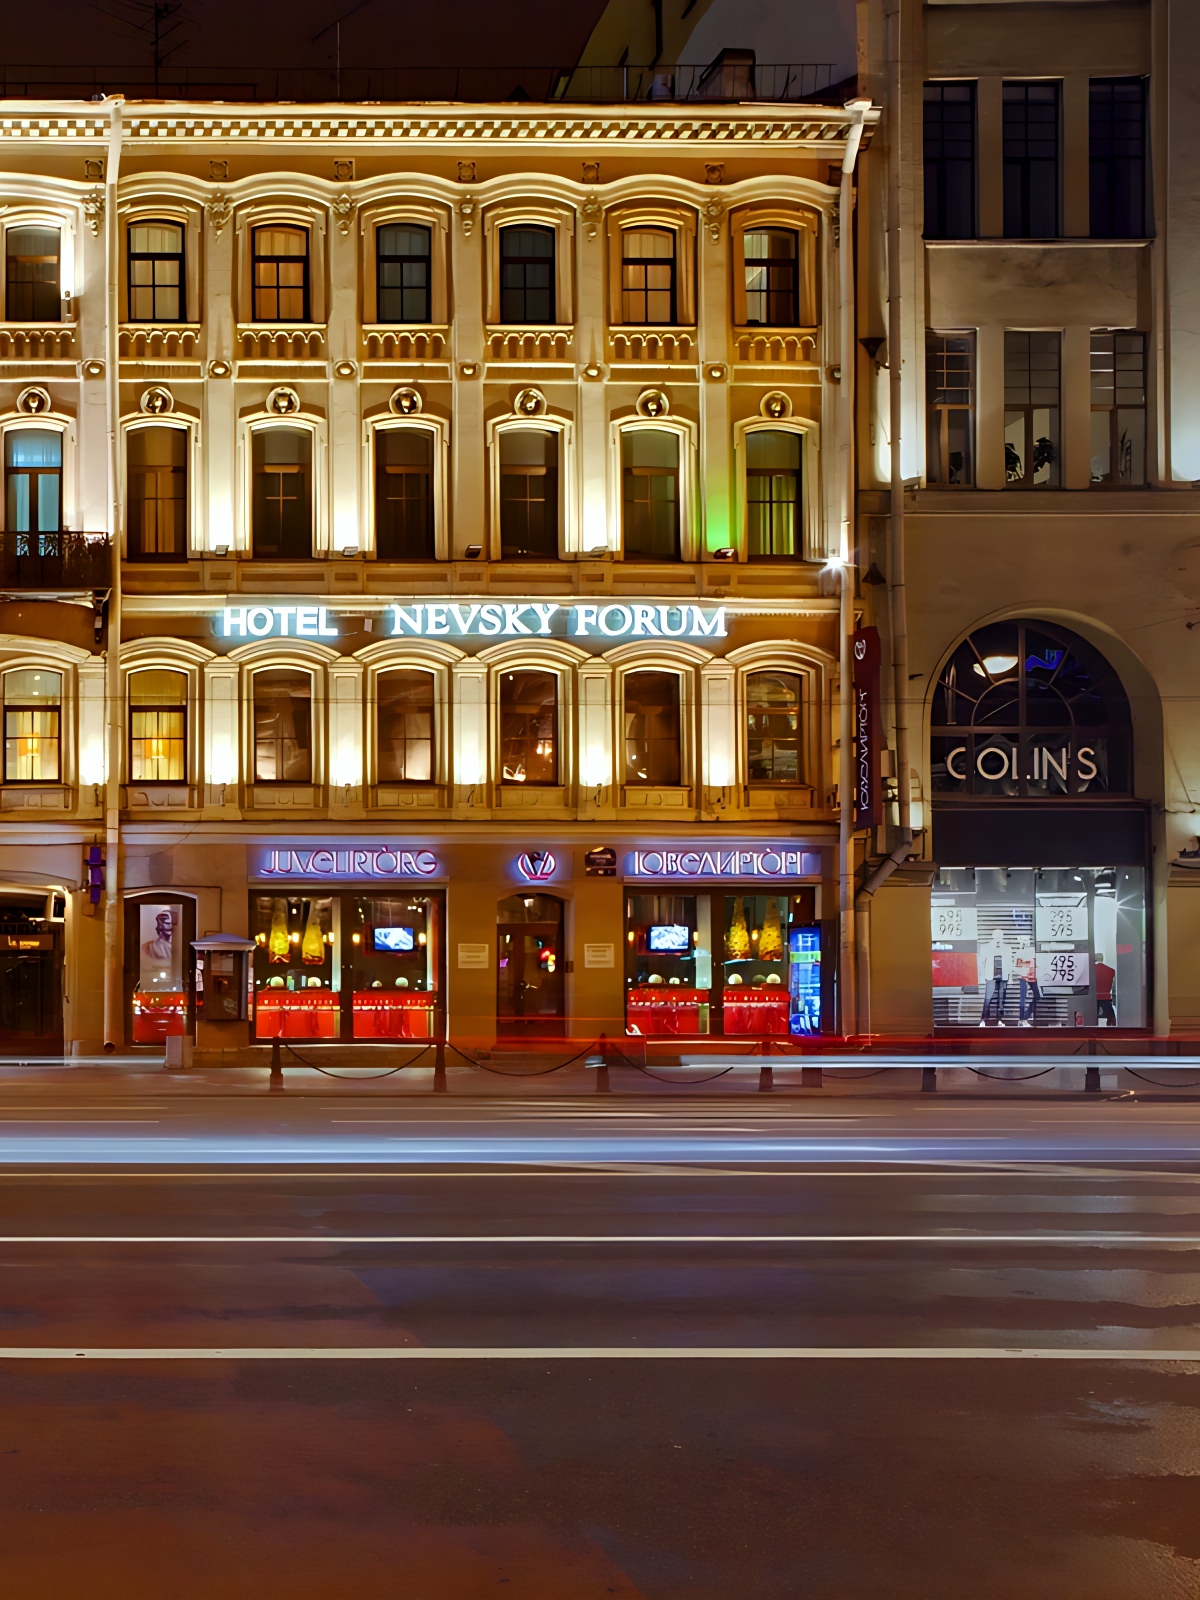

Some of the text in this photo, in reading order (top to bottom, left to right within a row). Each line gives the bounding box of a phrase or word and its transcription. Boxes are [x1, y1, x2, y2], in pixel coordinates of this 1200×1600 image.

[223, 603, 728, 637] HOTEL NEVSKY FORUM
[260, 845, 438, 875] JUVELIRTORG
[1050, 955, 1075, 969] 495
[1051, 968, 1075, 982] 795
